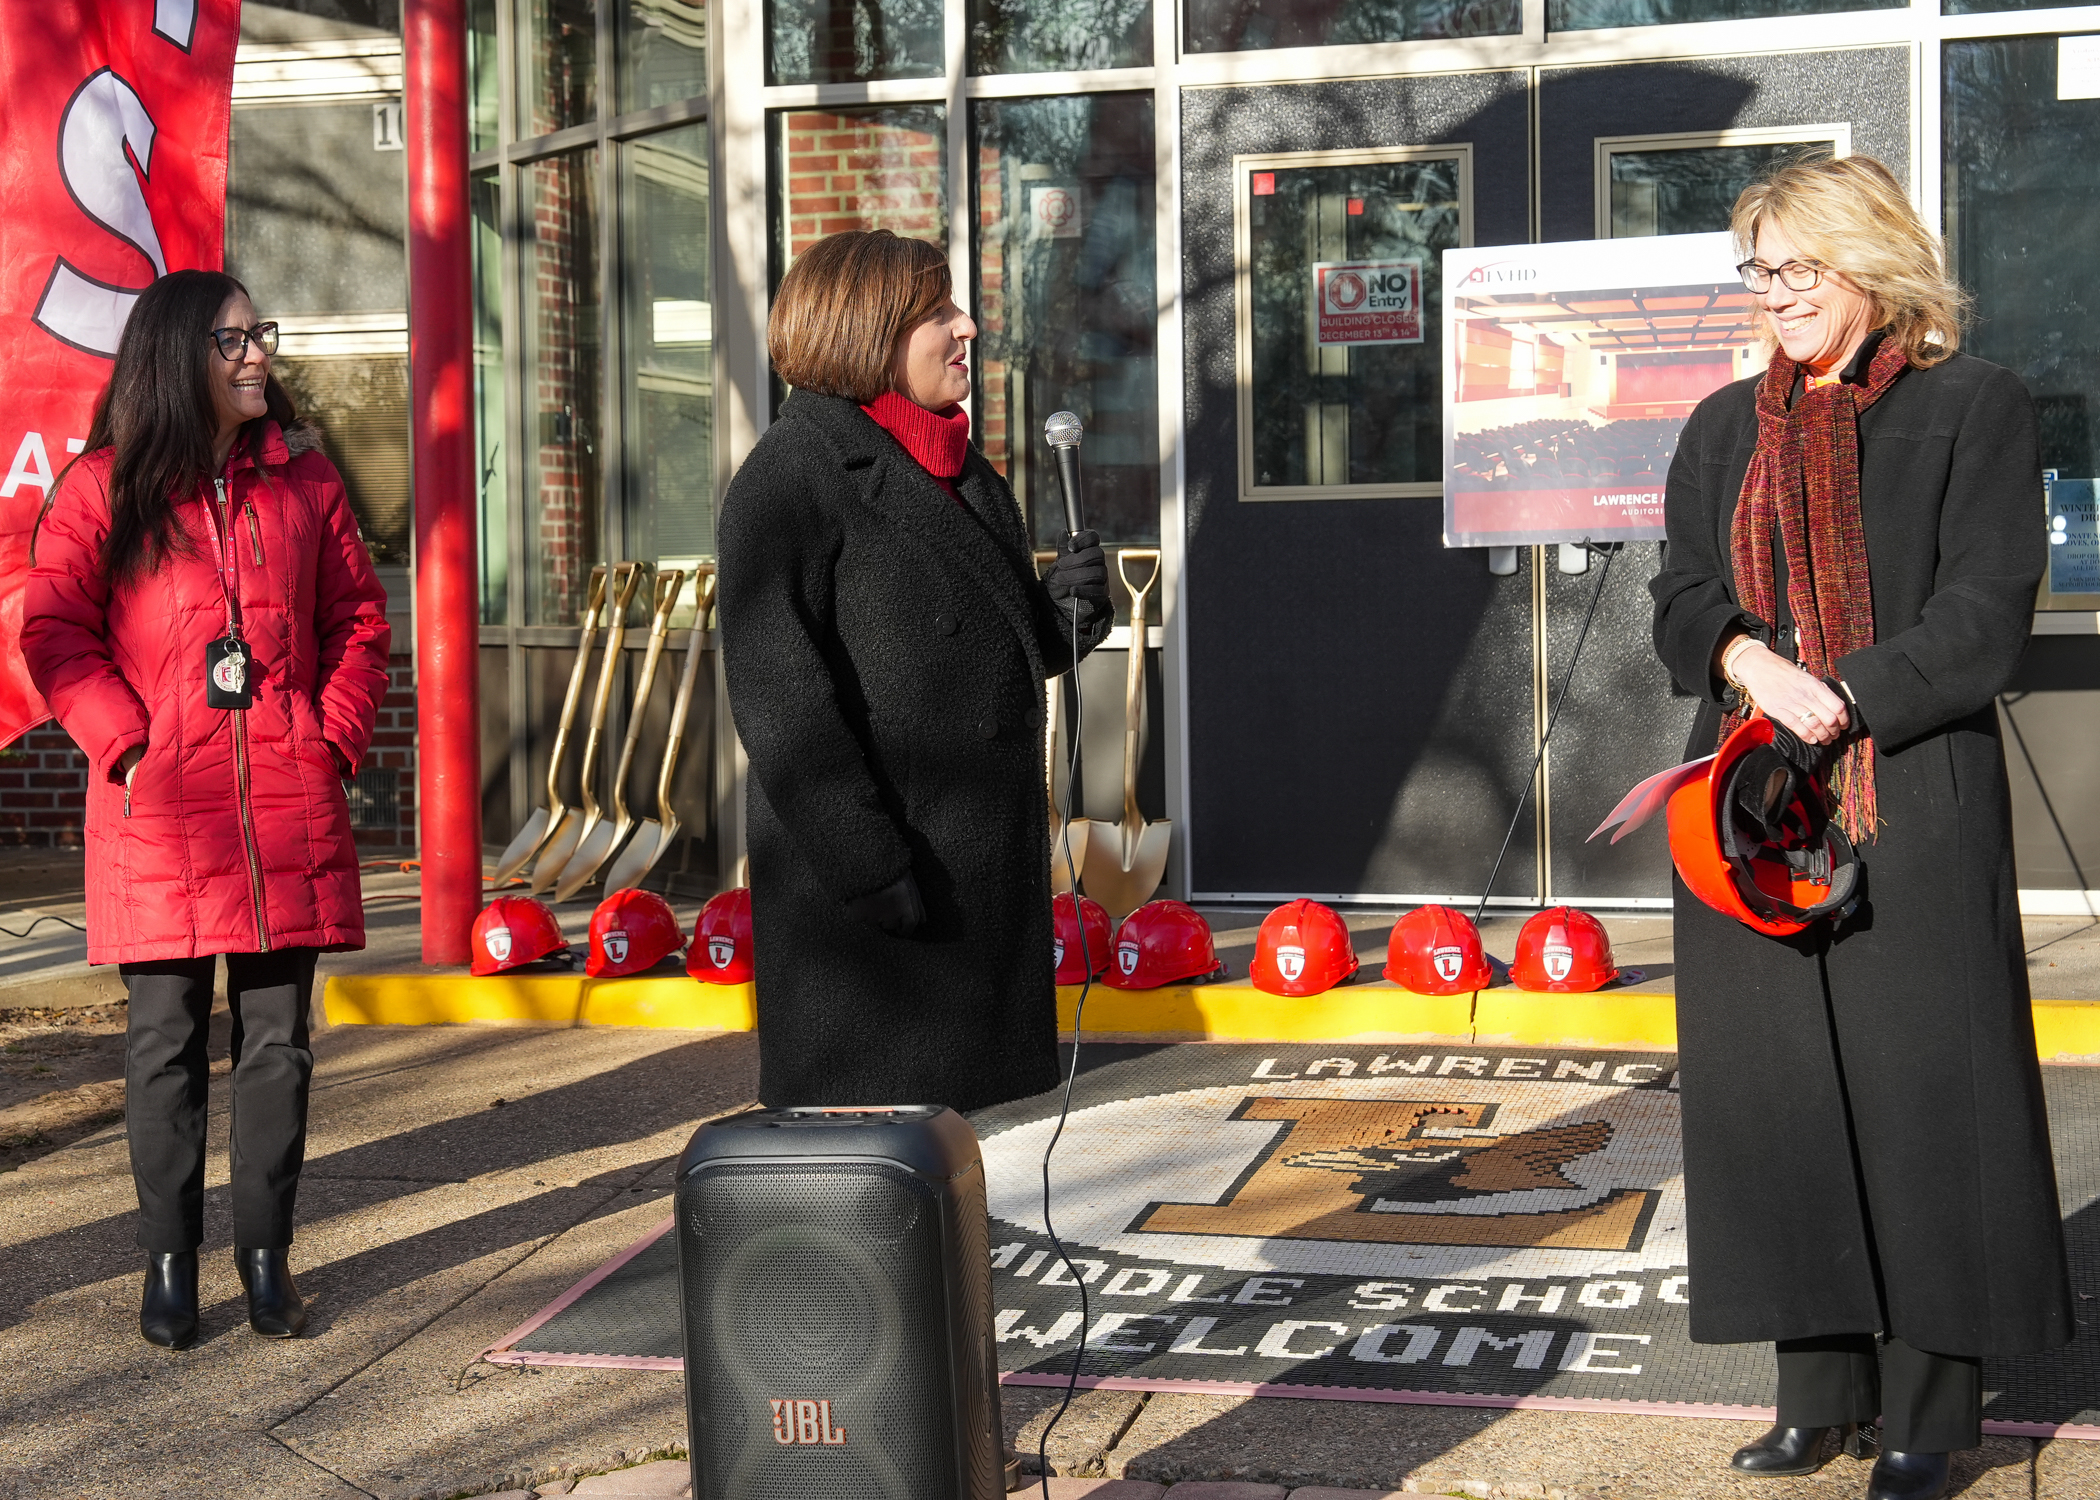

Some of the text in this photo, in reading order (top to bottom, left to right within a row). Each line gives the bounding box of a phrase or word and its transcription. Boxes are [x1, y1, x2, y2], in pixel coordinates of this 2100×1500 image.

[378, 107, 403, 145] 1
[1369, 273, 1407, 293] NO
[1369, 295, 1407, 309] Entry
[1321, 313, 1417, 328] BUILDING CLOSED
[1320, 330, 1371, 341] DECEMBER
[1593, 493, 1658, 506] LAWRENCE
[1621, 507, 1664, 516] AUDITORI
[494, 940, 506, 956] L
[610, 942, 624, 959] L
[715, 947, 727, 964] L
[1123, 953, 1132, 970] L
[1285, 958, 1297, 975] L
[1443, 959, 1456, 976] L
[1551, 958, 1564, 975] L
[1250, 1055, 1679, 1090] LAWRENC
[994, 1309, 1651, 1375] WELCOME
[770, 1399, 846, 1445] JBL
